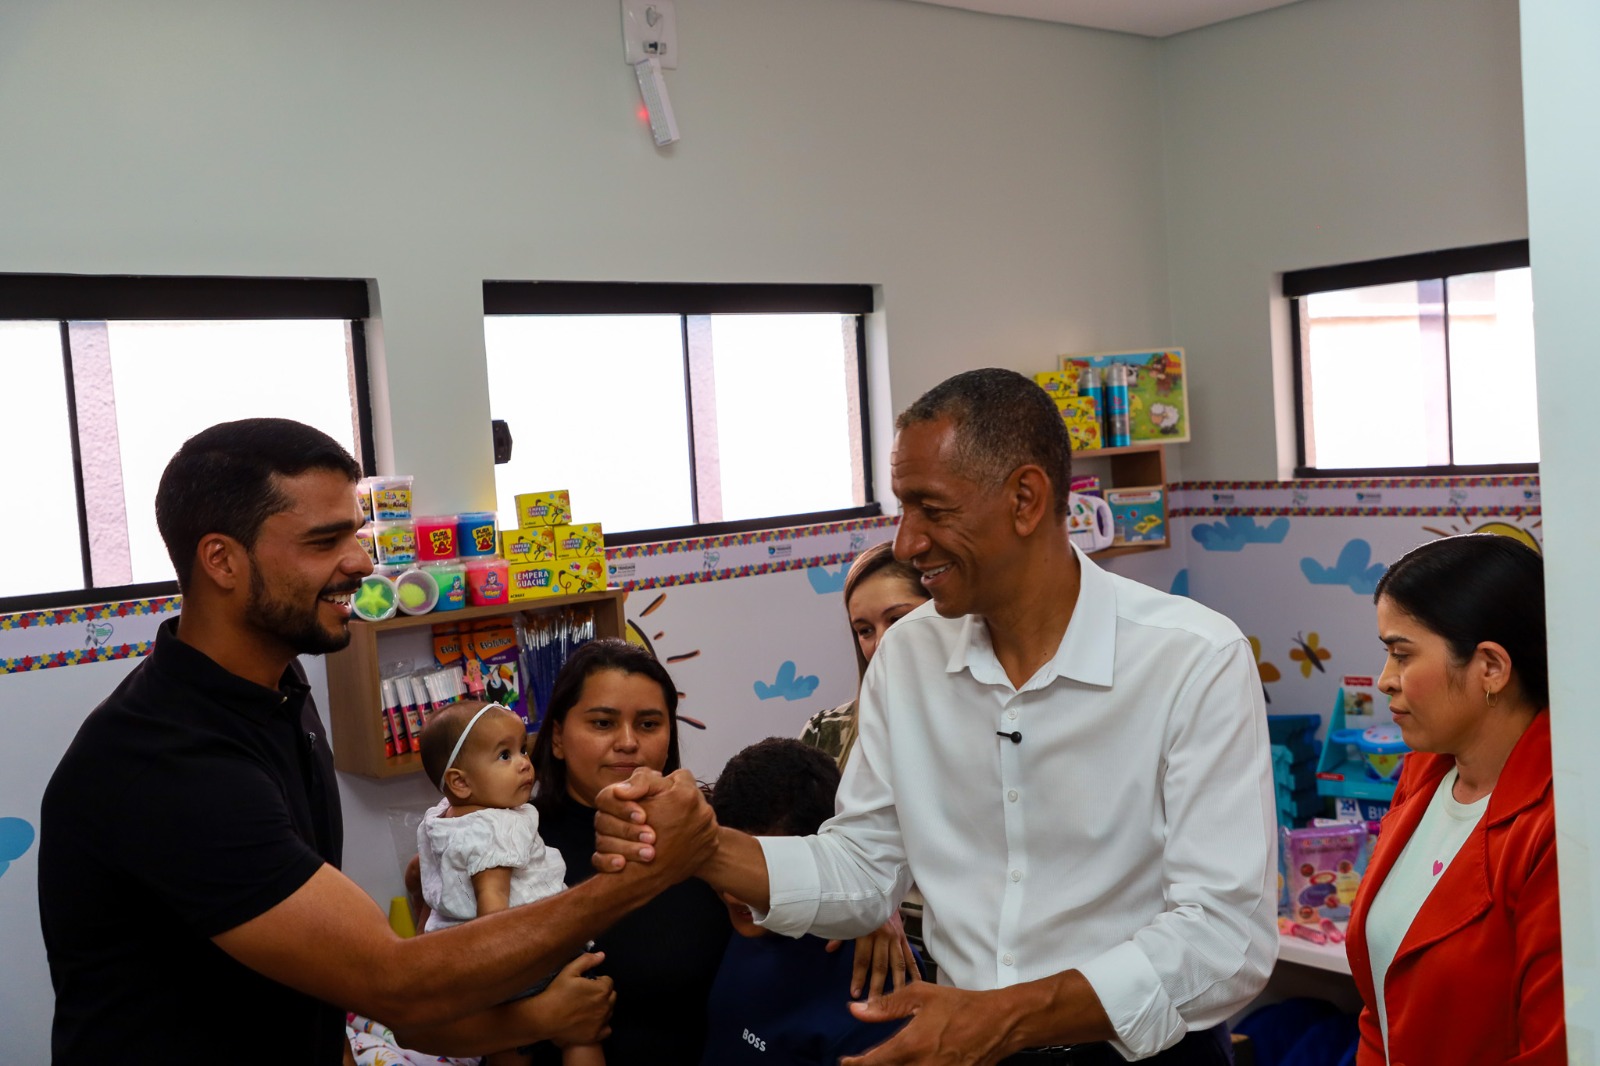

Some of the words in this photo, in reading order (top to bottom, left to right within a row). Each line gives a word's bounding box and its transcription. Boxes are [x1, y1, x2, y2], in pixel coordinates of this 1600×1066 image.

[513, 570, 549, 580] TEMPERA
[516, 579, 546, 588] GUACHE
[742, 1028, 766, 1052] BOSS
